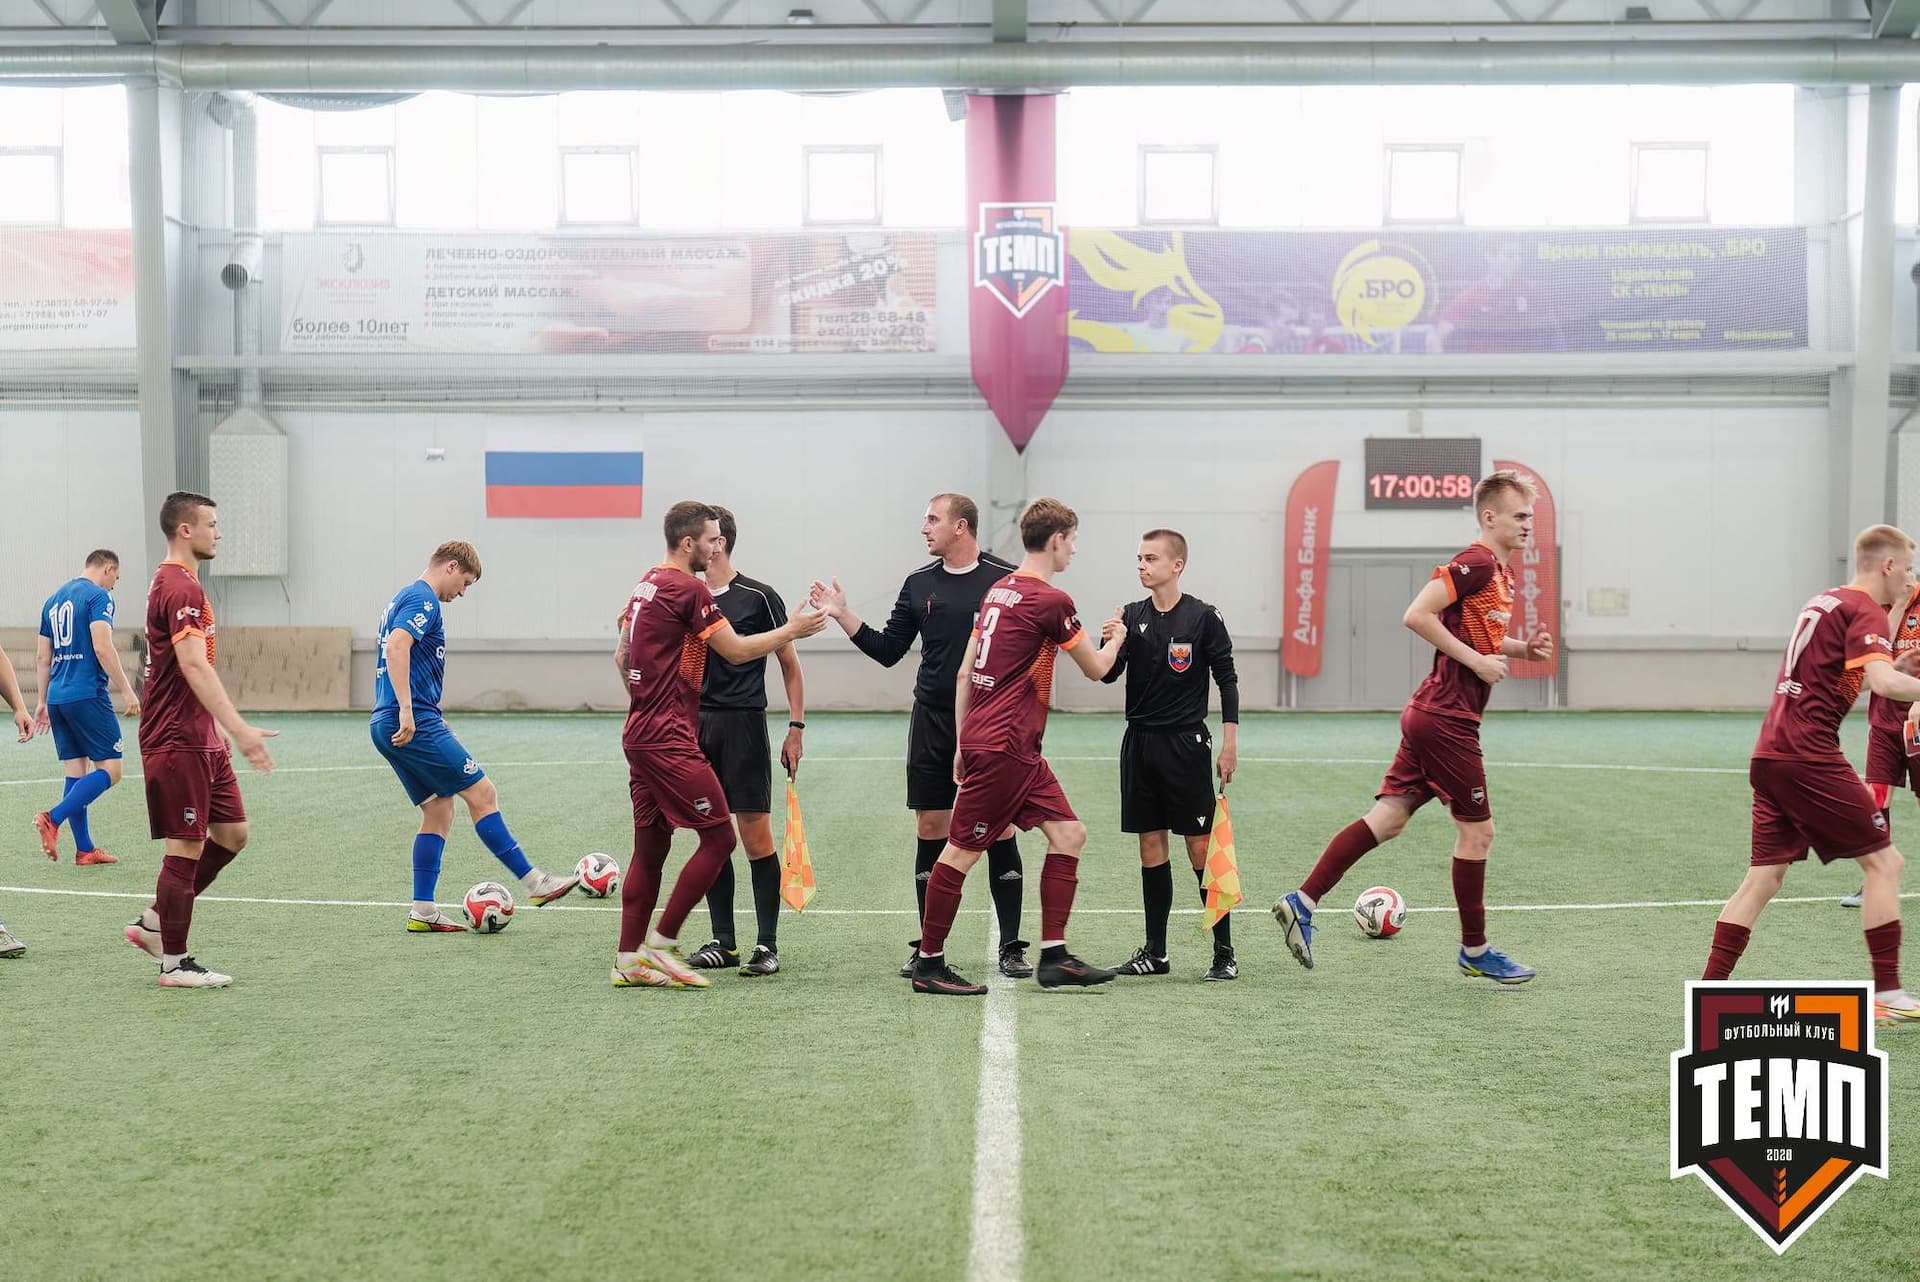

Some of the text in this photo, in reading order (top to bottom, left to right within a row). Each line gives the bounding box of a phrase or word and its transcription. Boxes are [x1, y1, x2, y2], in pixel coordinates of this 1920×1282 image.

[982, 235, 1055, 274] ТЕМП
[1537, 242, 1598, 261] Время
[859, 254, 909, 281] 20%
[425, 285, 499, 300] ДЕТСКИЙ
[1358, 279, 1416, 299] .БРО
[292, 318, 351, 334] более
[1369, 475, 1472, 499] 17:00:58
[1293, 506, 1318, 644] Альфа Банк
[49, 600, 74, 649] 10
[974, 606, 1001, 670] 3
